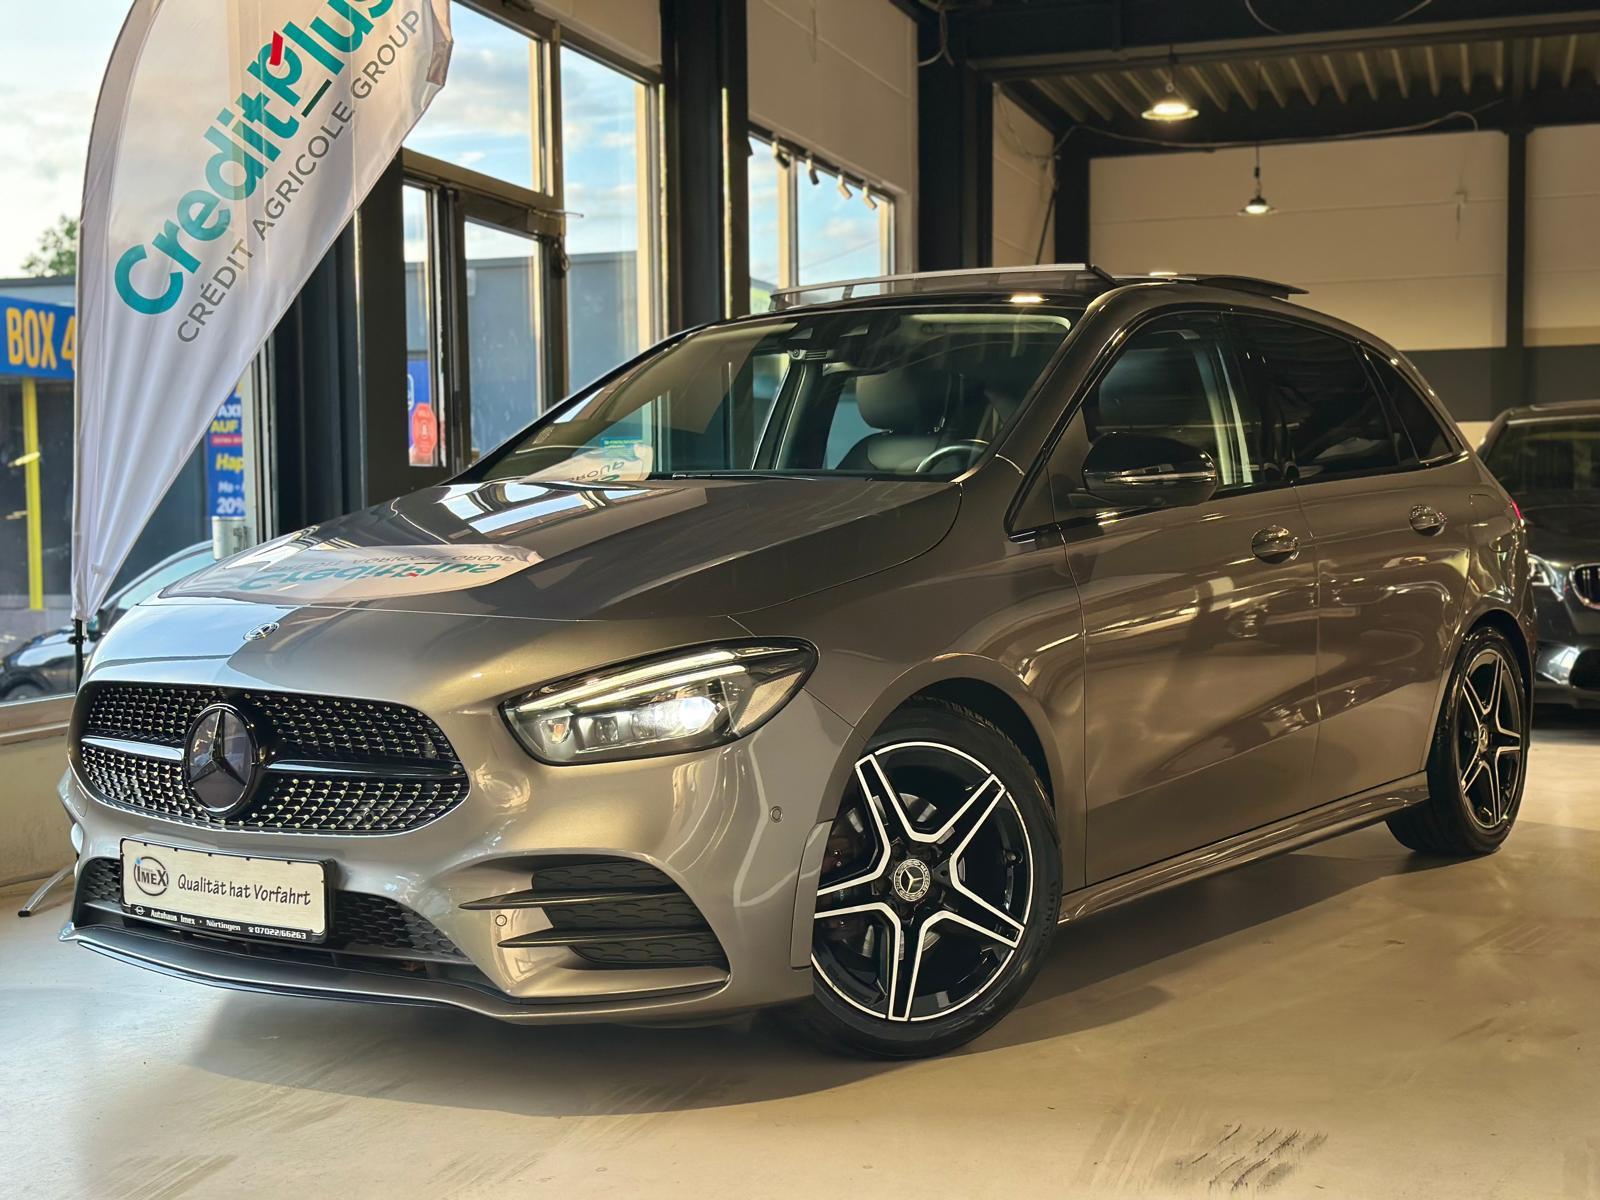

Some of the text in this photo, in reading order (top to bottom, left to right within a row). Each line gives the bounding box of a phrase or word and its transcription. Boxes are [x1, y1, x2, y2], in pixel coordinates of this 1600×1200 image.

[177, 10, 420, 343] CRÉDIT AGRICOLE GROUP
[6, 307, 76, 369] BOX 4
[178, 874, 311, 905] Qualität hat Vorfahrt
[150, 909, 178, 922] Autohaus
[206, 919, 241, 931] Nürtingen
